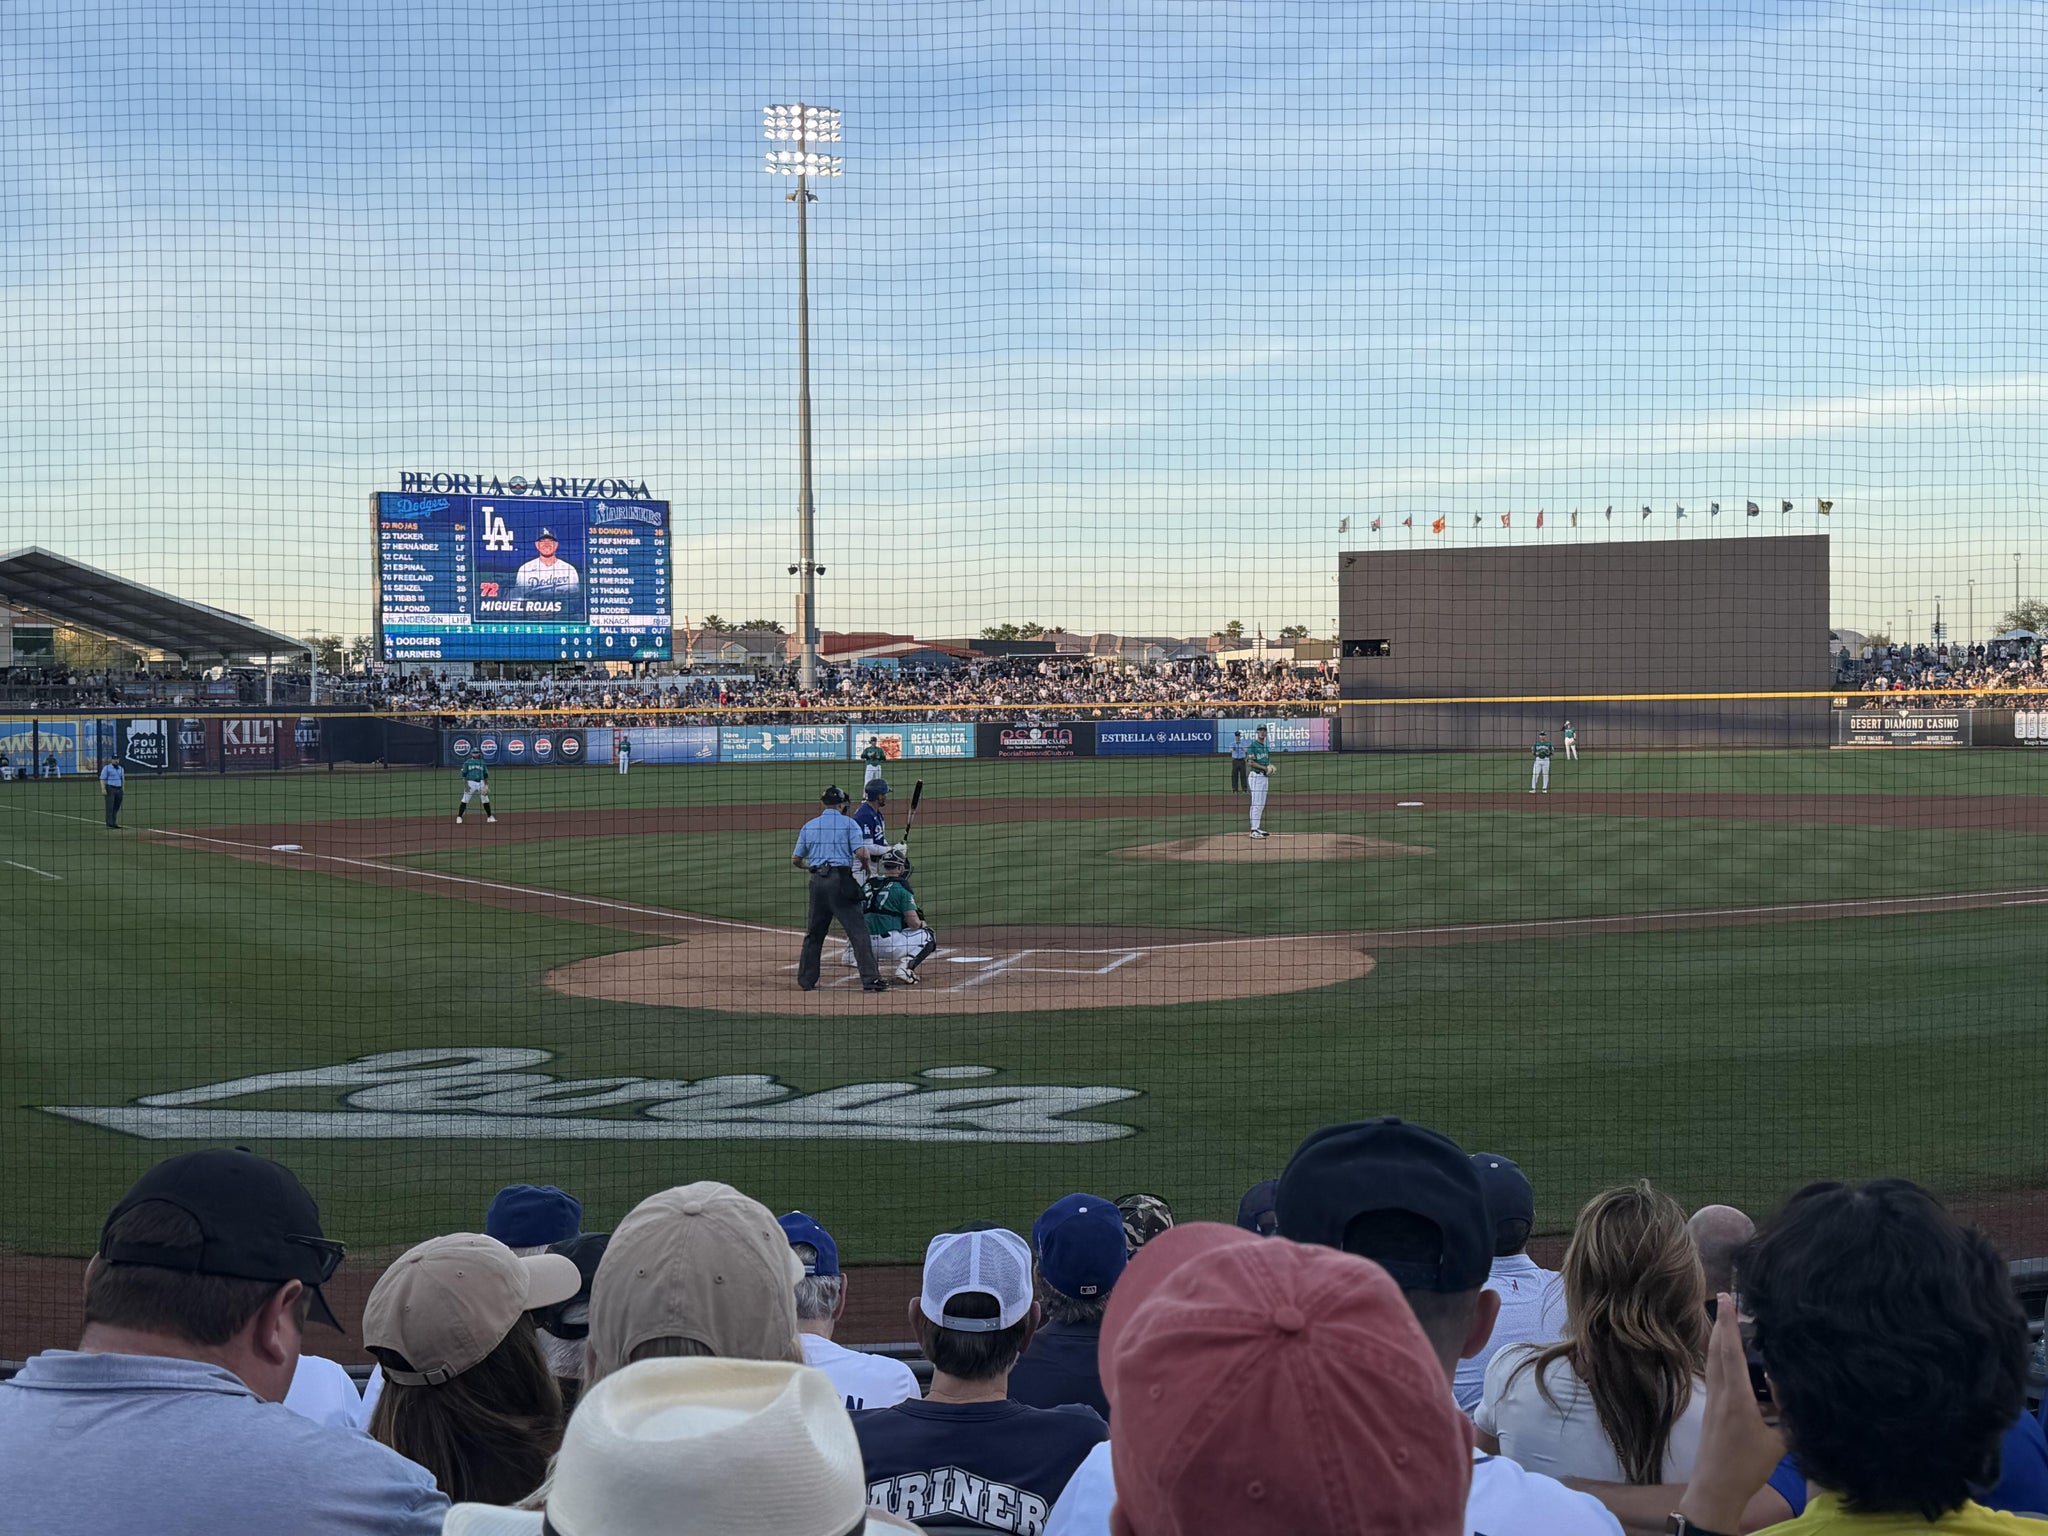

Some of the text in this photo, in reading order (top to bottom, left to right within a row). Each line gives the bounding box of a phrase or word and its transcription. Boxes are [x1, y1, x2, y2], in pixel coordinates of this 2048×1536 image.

[399, 471, 652, 499] PEORIA ARIZONA
[397, 497, 450, 518] Dodgers
[595, 503, 662, 526] MARINERS
[392, 522, 418, 530] ROJAS
[482, 506, 514, 551] LA
[392, 553, 414, 561] CALL
[393, 584, 423, 592] SENZEL
[480, 582, 499, 597] 72
[480, 601, 562, 612] MIGUEL ROJAS
[397, 615, 444, 624] ANDERSON
[451, 616, 468, 624] LHP
[396, 637, 442, 646] DODGERS
[561, 637, 567, 645] 0
[573, 637, 580, 645] 0
[586, 637, 592, 645] 0
[605, 636, 663, 647] 0 0 0
[385, 648, 592, 659] S MARINERS 0 0 0
[643, 651, 659, 659] MPH
[1850, 718, 1959, 729] DESERT DIAMOND CASINO
[178, 731, 205, 745] KILT
[223, 720, 283, 745] KILT
[294, 729, 320, 742] KILT
[1101, 732, 1212, 743] ESTRELLA JALISCO
[1276, 726, 1310, 740] tickets
[817, 733, 844, 744] SOD
[911, 733, 931, 744] REAL
[914, 745, 934, 755] REAL
[110, 1046, 1141, 1141] Peoria
[867, 1465, 1052, 1536] ARINER
